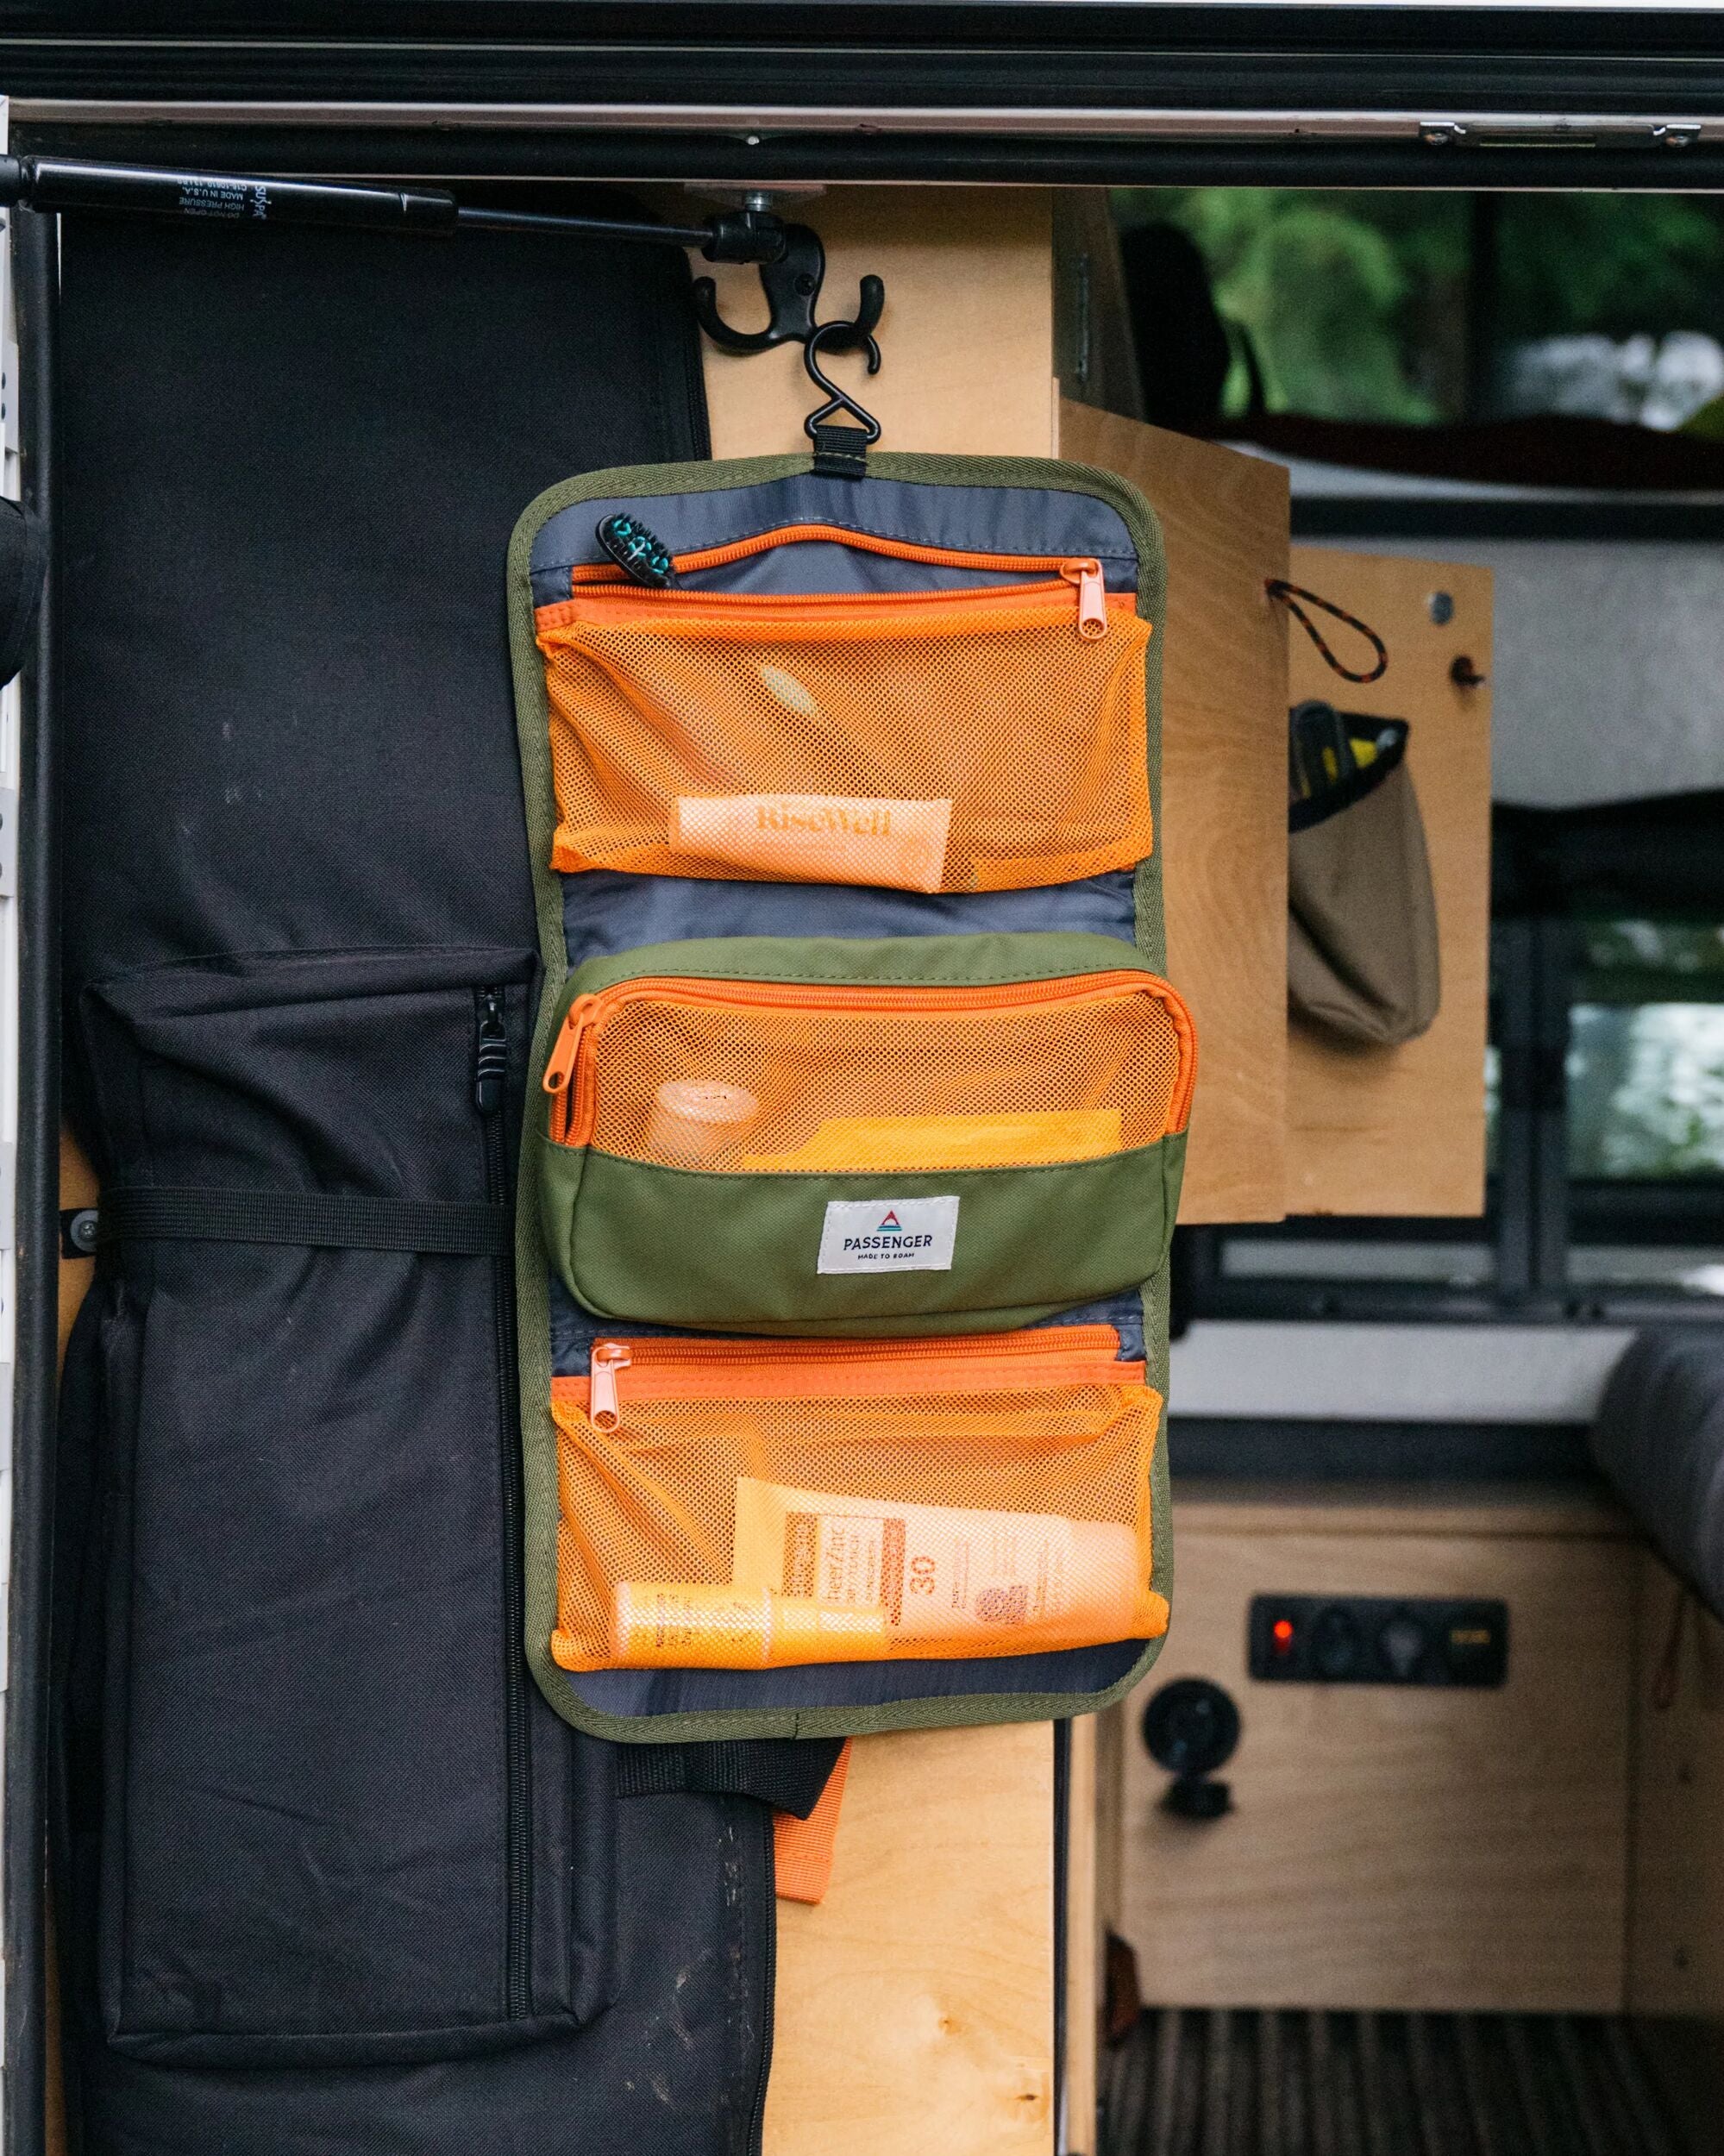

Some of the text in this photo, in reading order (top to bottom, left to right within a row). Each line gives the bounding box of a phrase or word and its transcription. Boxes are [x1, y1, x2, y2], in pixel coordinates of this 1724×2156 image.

[182, 186, 209, 197] U.S.A.
[221, 191, 243, 201] MADE
[179, 197, 245, 211] HIGH PRESSURE
[843, 1234, 933, 1251] PASSENGER
[910, 1556, 936, 1595] 30
